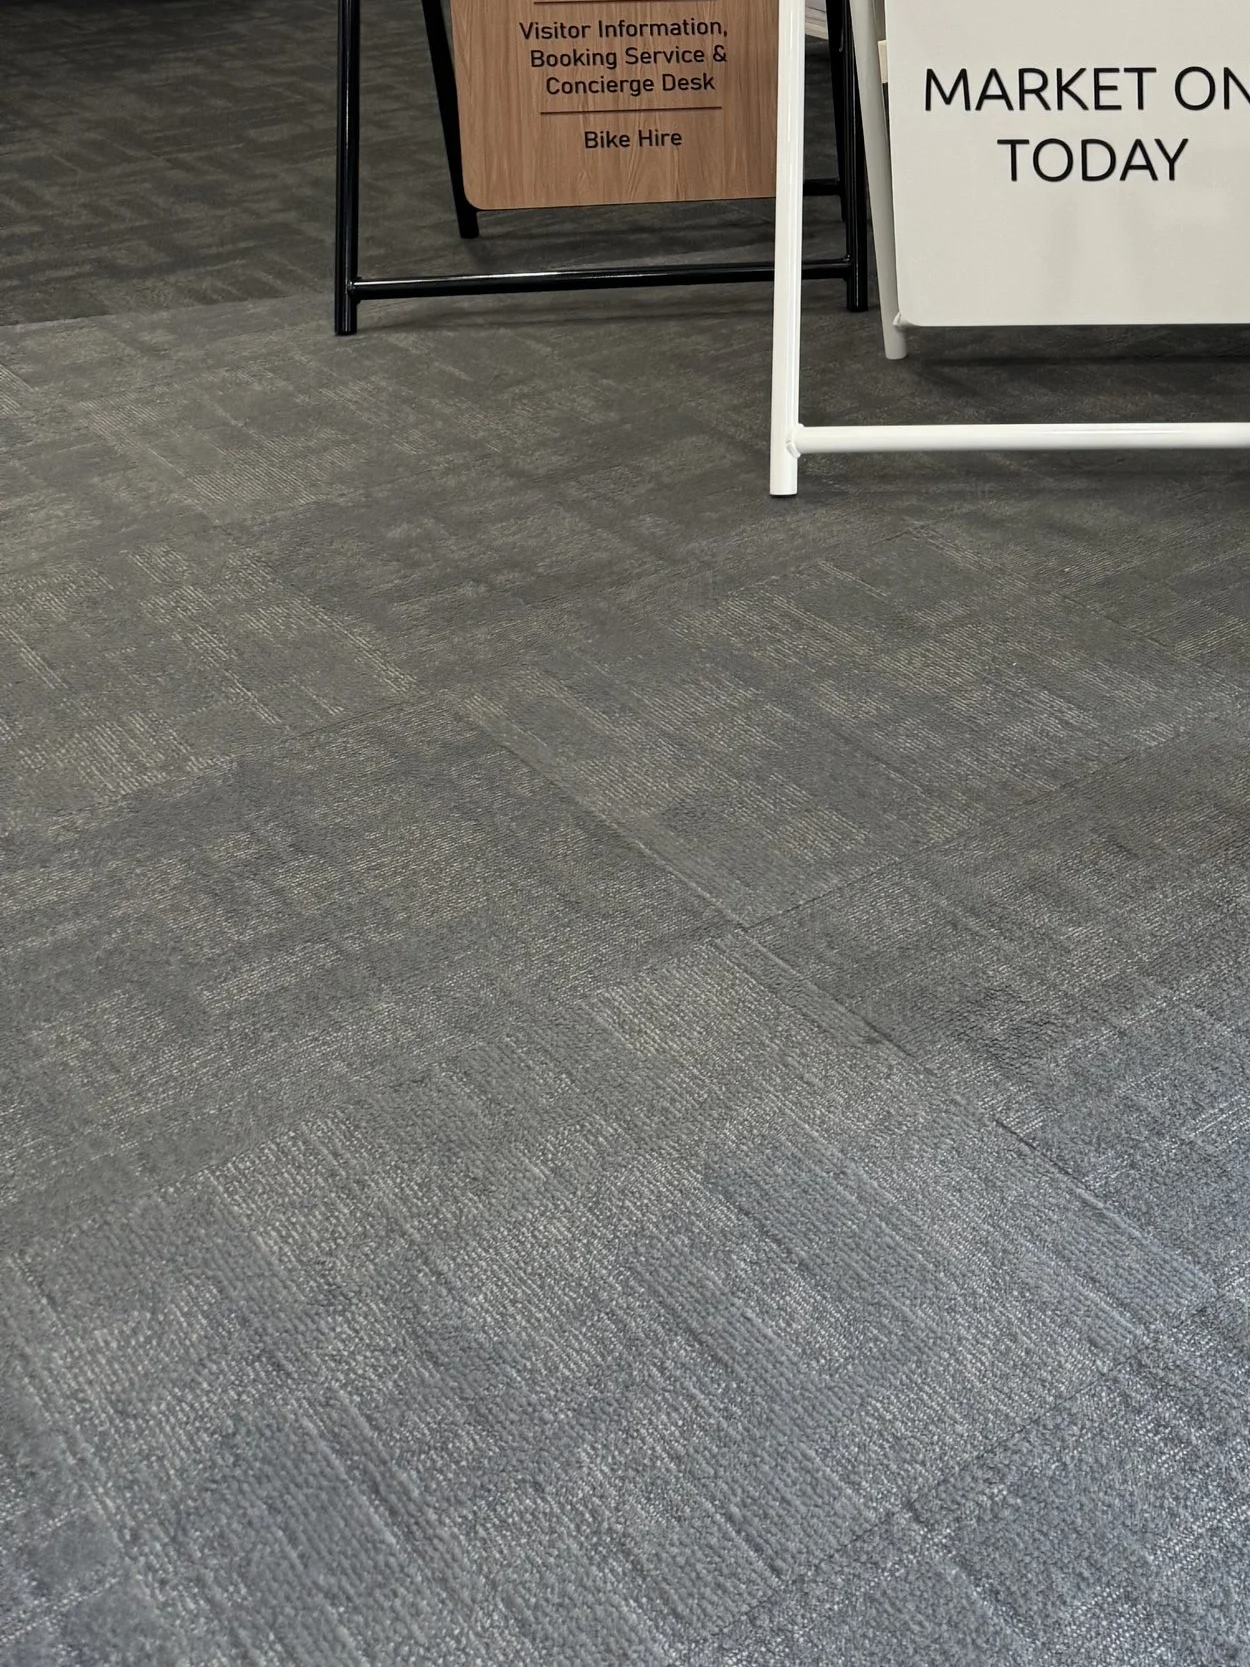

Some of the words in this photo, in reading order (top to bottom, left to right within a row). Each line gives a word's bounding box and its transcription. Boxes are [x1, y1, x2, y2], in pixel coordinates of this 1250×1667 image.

[518, 21, 591, 40] Visitor
[598, 17, 728, 38] Information,
[530, 48, 617, 70] Booking
[624, 45, 705, 65] Service
[712, 44, 728, 62] &
[546, 75, 655, 97] Concierge
[661, 72, 717, 92] Desk
[924, 67, 1157, 112] MARKET
[584, 130, 631, 149] Bike
[638, 129, 683, 148] Hire
[996, 137, 1189, 183] TODAY
